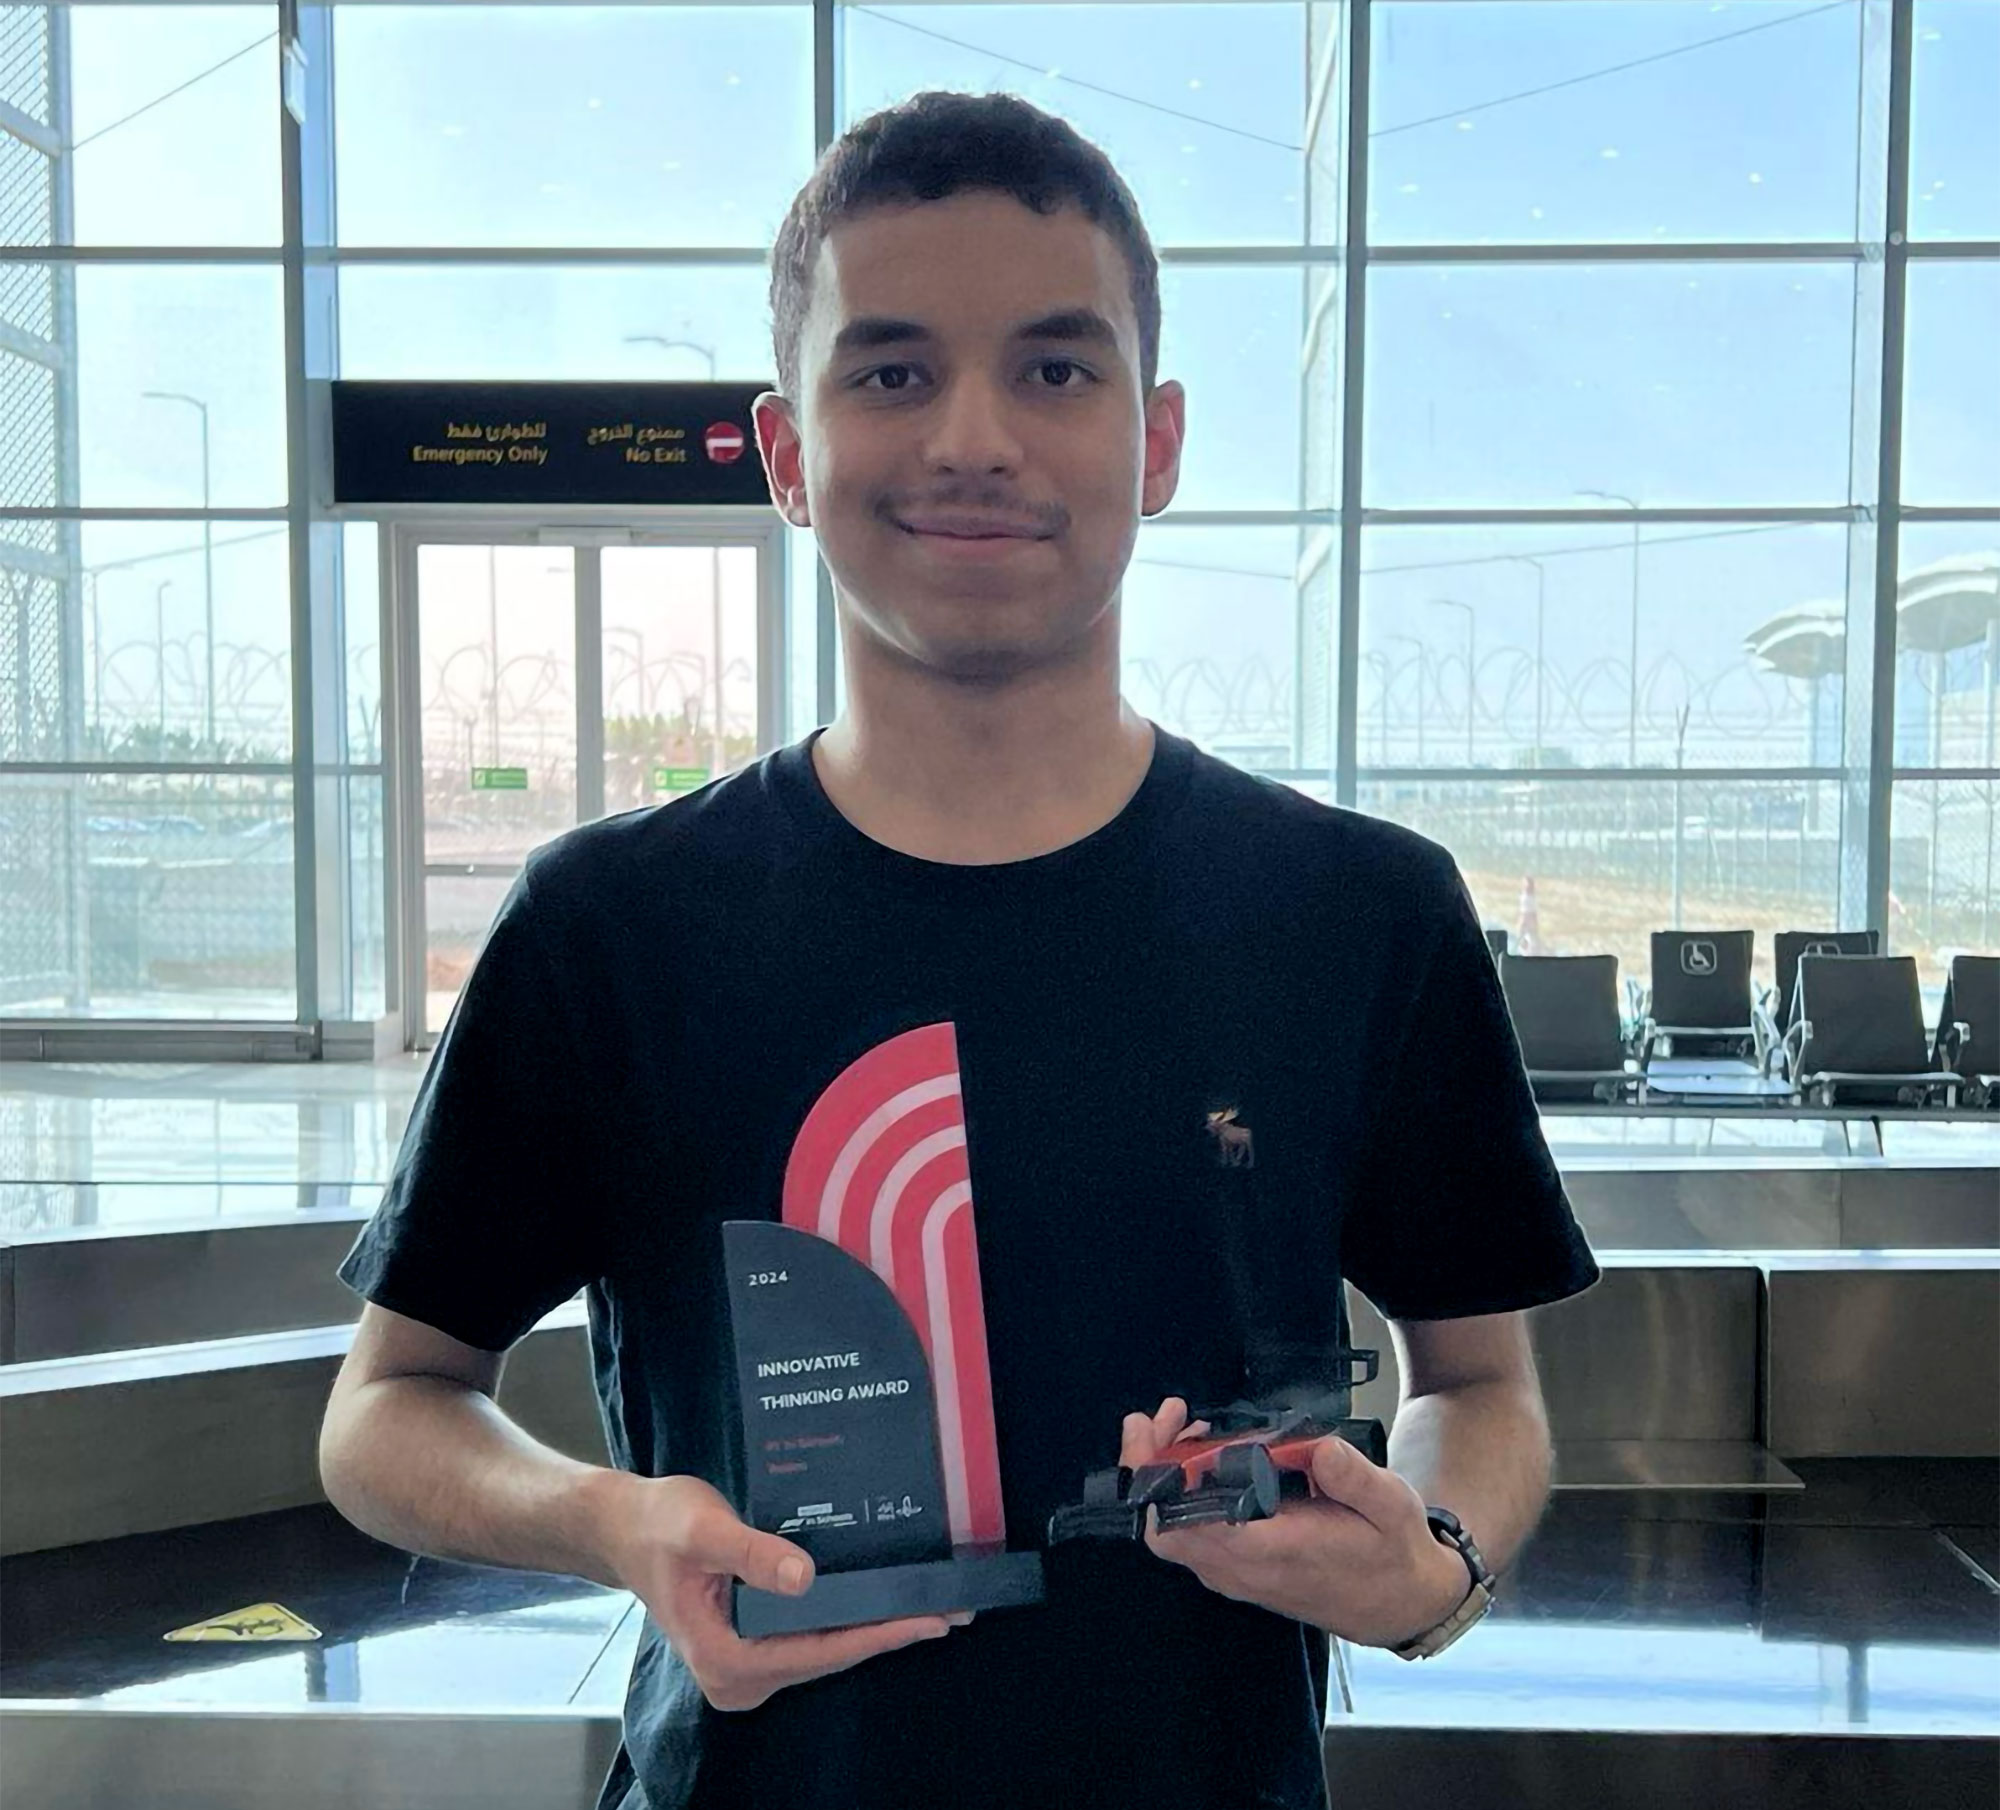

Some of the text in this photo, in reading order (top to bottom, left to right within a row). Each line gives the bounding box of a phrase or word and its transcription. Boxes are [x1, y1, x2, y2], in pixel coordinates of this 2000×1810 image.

[447, 422, 482, 438] فقط
[587, 424, 684, 446] ممنوع الخروج
[413, 446, 548, 466] Emergency Only
[626, 447, 686, 463] No Exit
[749, 1270, 788, 1286] 2024
[758, 1352, 860, 1377] INNOVATIVE
[760, 1379, 909, 1410] THINKING AWARD
